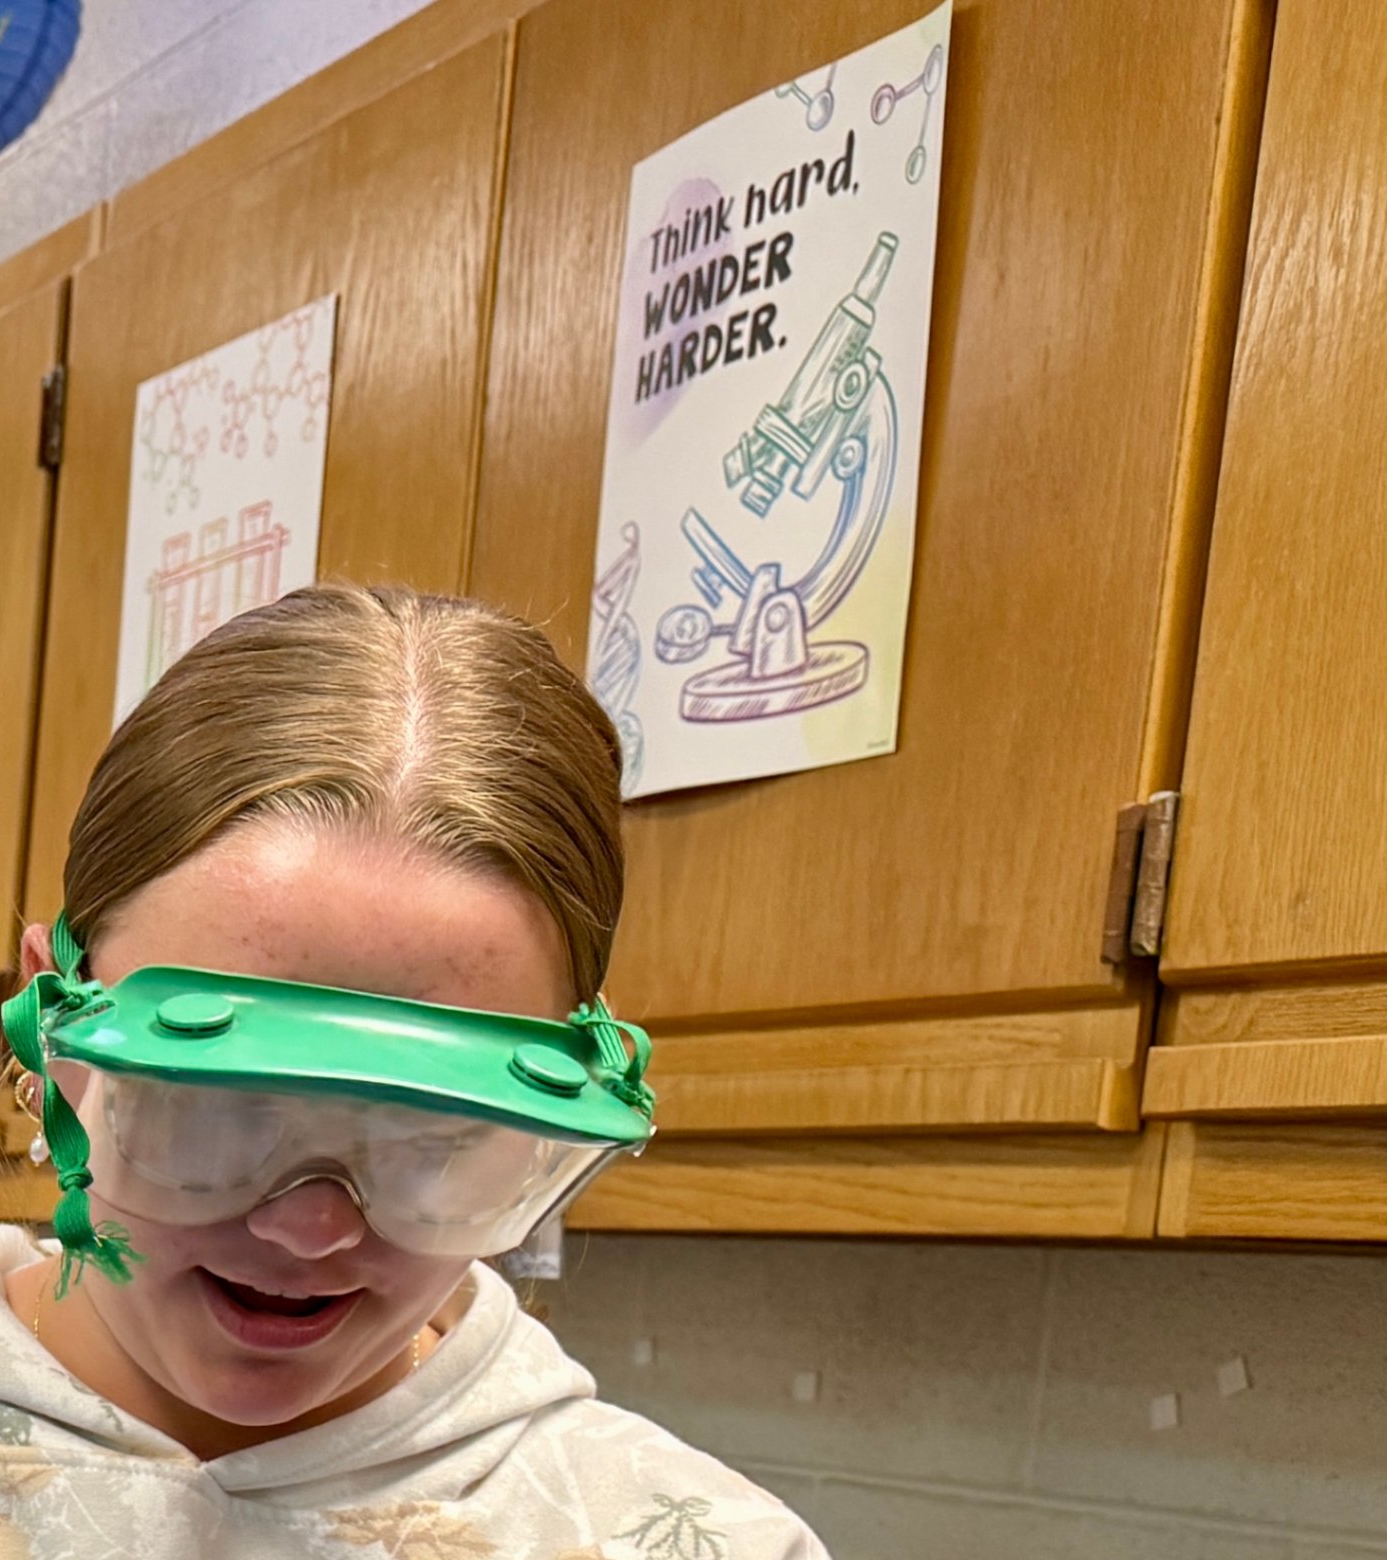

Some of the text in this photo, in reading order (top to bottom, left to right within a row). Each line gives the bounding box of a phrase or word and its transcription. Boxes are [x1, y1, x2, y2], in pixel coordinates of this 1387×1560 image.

[651, 129, 859, 273] Think hard,
[644, 231, 793, 340] WONDER
[634, 303, 786, 402] HARDER.
